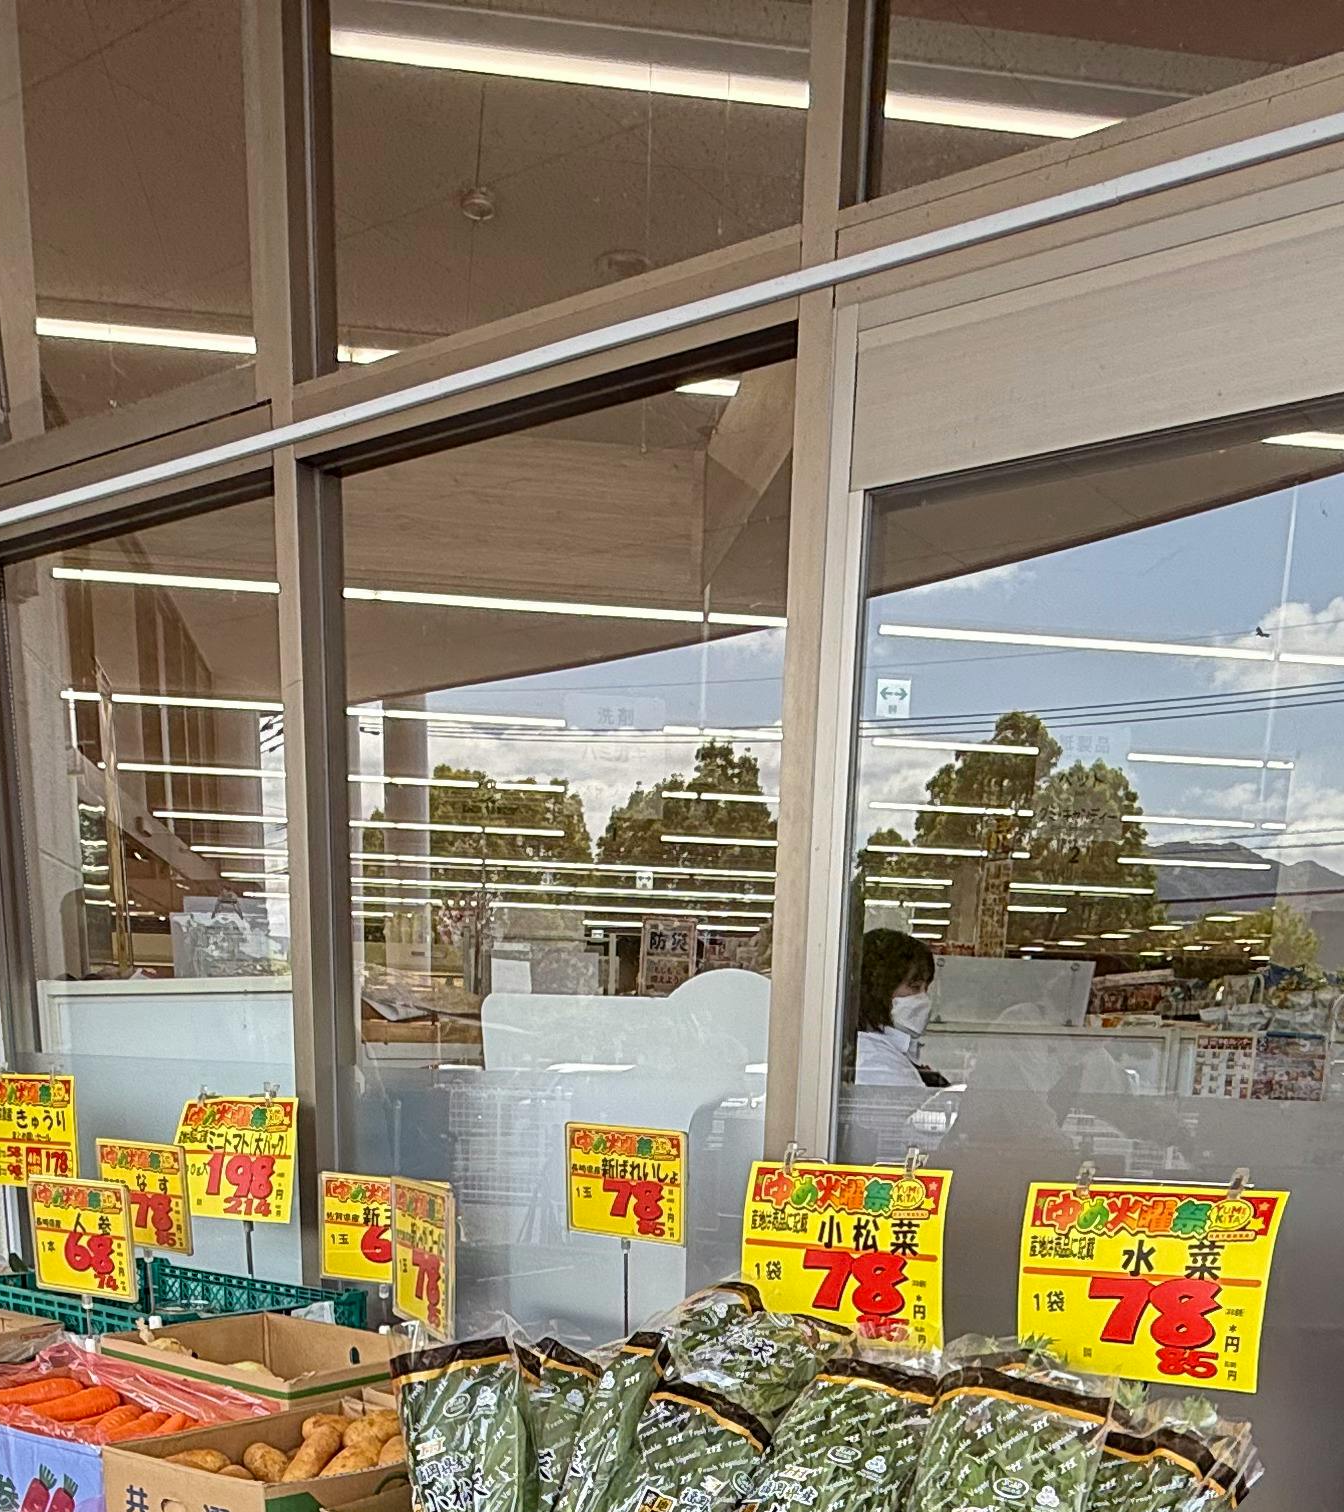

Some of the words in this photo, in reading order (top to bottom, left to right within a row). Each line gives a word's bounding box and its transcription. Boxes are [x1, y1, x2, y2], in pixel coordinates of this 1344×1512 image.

[649, 930, 688, 952] 防災
[16, 1108, 66, 1131] きゅうり
[135, 1173, 169, 1194] なす
[205, 1152, 275, 1199] 198
[601, 1157, 679, 1185] 新ばれいしょ
[129, 1192, 174, 1232] 78
[223, 1197, 272, 1217] 214
[603, 1178, 665, 1221] 78
[763, 1172, 894, 1213] ゆめ火曜祭
[73, 1212, 112, 1236] 人参
[1045, 1192, 1213, 1236] ゆめ火曜祭
[64, 1231, 116, 1275] 68
[330, 1233, 350, 1245] 1玉
[817, 1214, 920, 1257] 小松菜
[412, 1247, 441, 1307] 78
[1029, 1235, 1097, 1261] 産地は商品に記載
[1121, 1239, 1225, 1281] 水菜
[94, 1273, 120, 1291] 74
[754, 1259, 783, 1281] 1袋
[802, 1247, 910, 1317] 78
[913, 1304, 927, 1321] 円
[1032, 1290, 1065, 1312] 1袋
[1087, 1275, 1223, 1350] 78
[1223, 1335, 1240, 1353] 円
[1155, 1346, 1219, 1379] 85
